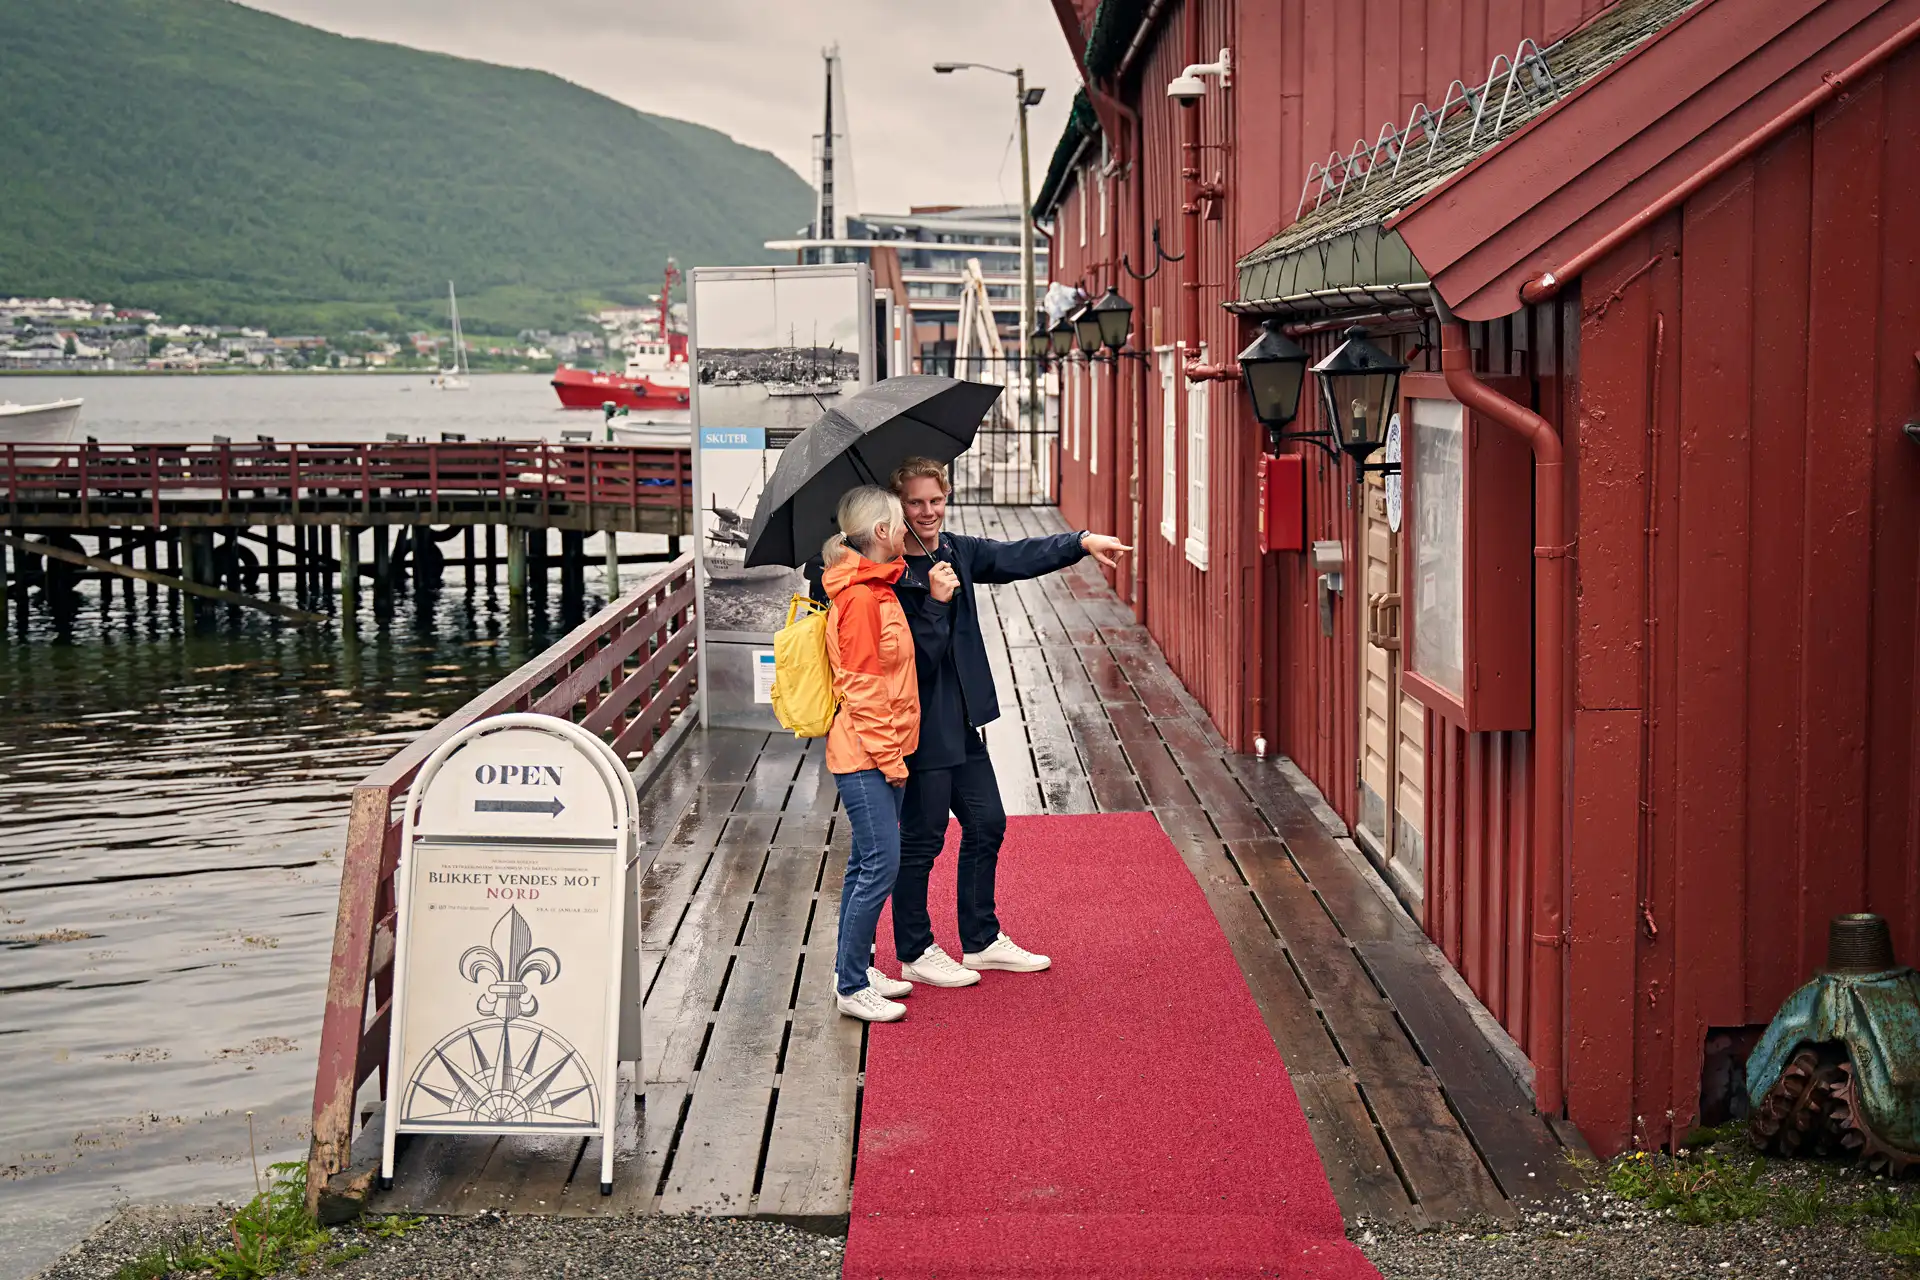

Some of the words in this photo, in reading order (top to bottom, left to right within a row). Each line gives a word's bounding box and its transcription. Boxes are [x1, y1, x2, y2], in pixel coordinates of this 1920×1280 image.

[705, 433, 748, 444] SKUTER
[475, 764, 564, 786] OPEN
[429, 871, 493, 885] BLIKKET
[498, 873, 557, 886] VENDES
[564, 875, 601, 887] MOT
[486, 887, 540, 900] NORD
